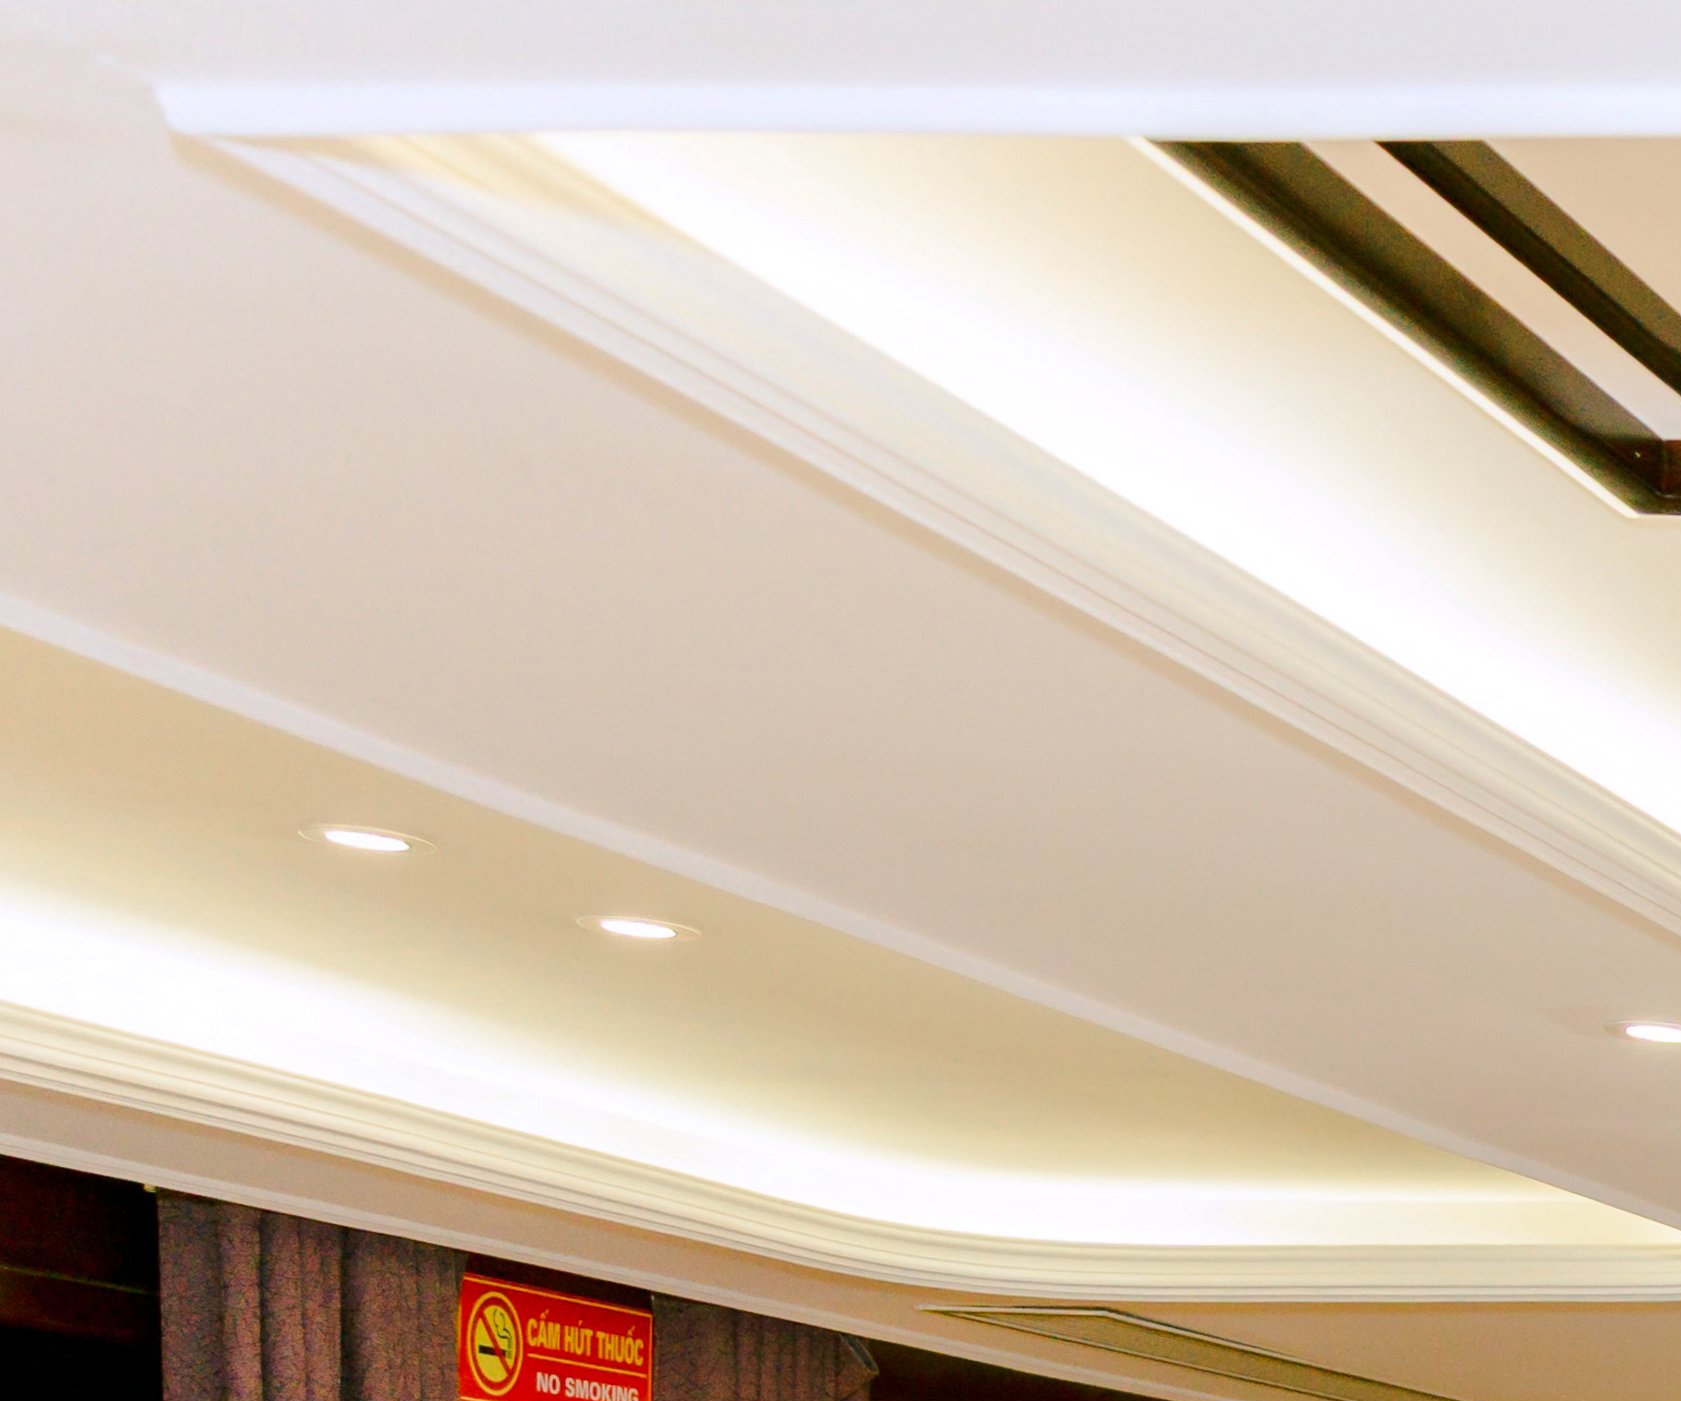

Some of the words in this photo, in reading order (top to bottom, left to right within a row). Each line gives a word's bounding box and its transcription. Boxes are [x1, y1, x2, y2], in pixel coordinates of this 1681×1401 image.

[527, 1309, 560, 1351] CẤM
[564, 1320, 593, 1356] HÚT
[597, 1325, 644, 1366] THUỐC
[536, 1372, 560, 1394] NO
